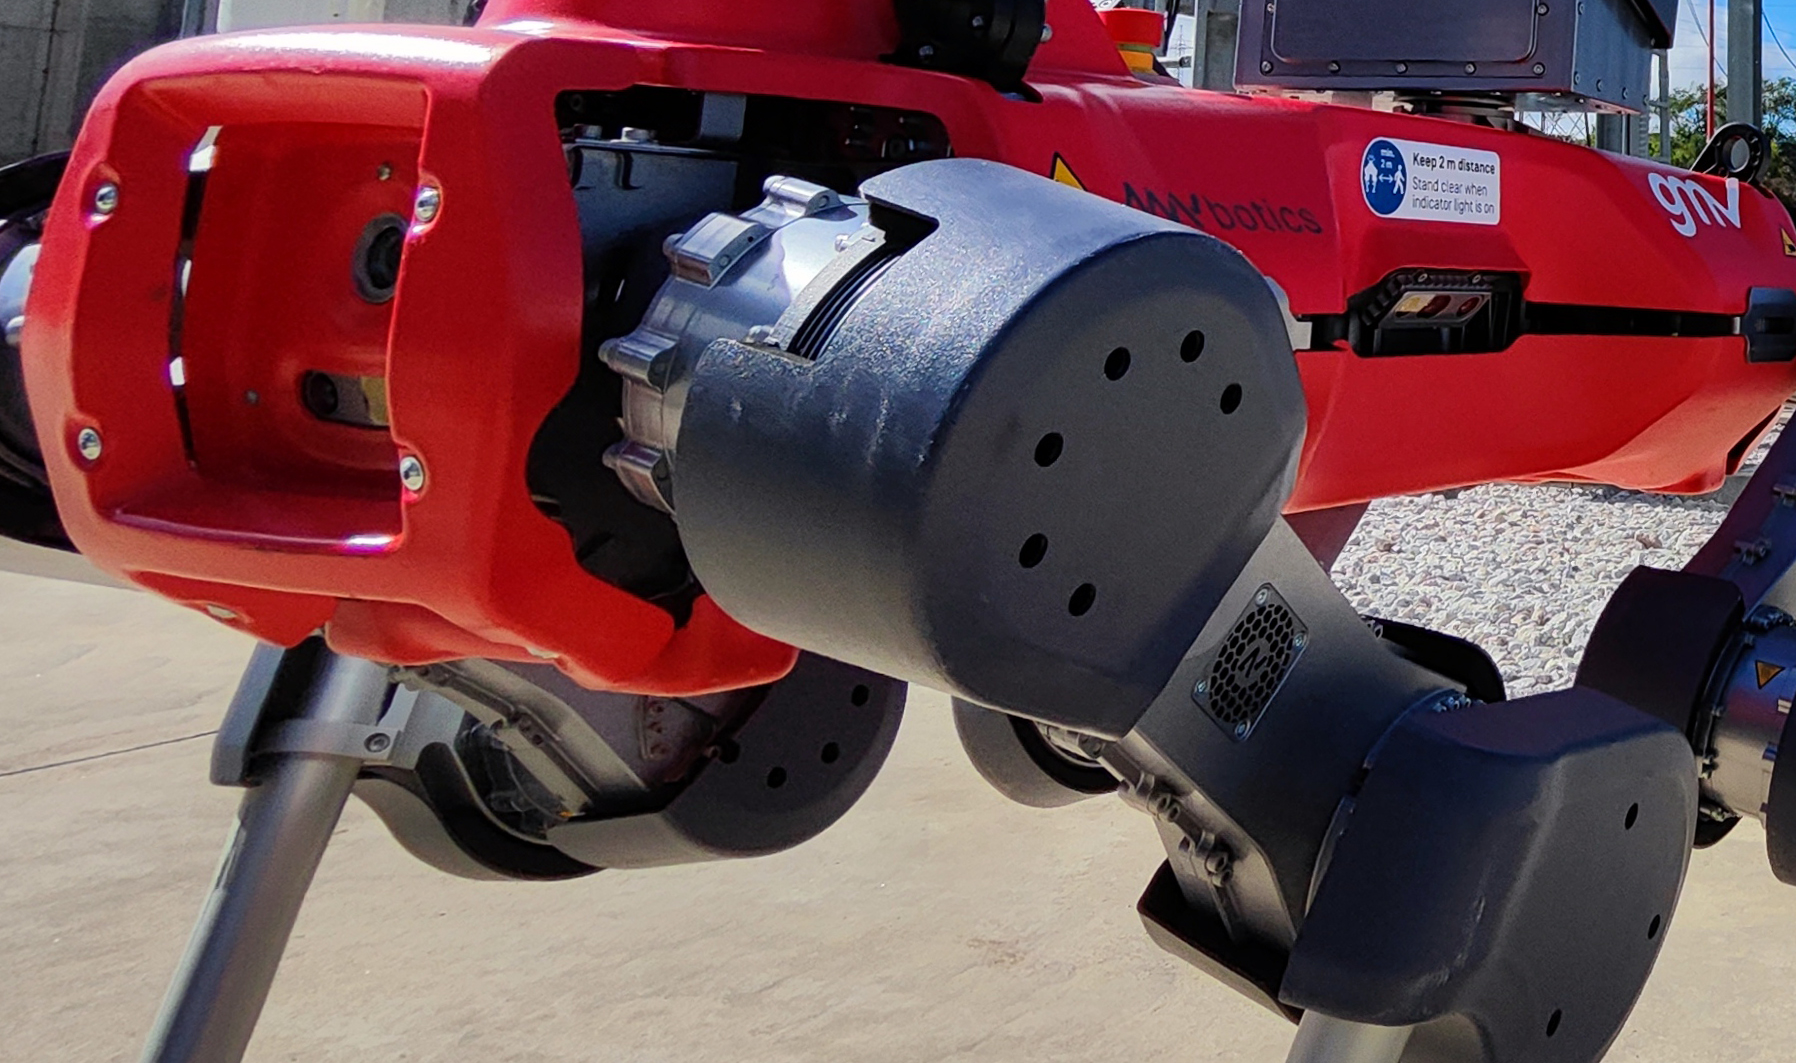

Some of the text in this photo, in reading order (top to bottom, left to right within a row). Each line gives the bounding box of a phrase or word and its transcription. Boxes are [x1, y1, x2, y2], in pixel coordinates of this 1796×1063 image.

[1380, 158, 1393, 169] 2 m
[1412, 152, 1495, 174] Keep 2 m distance
[1412, 176, 1488, 196] Stand clear when
[1412, 194, 1495, 215] indicator light is on
